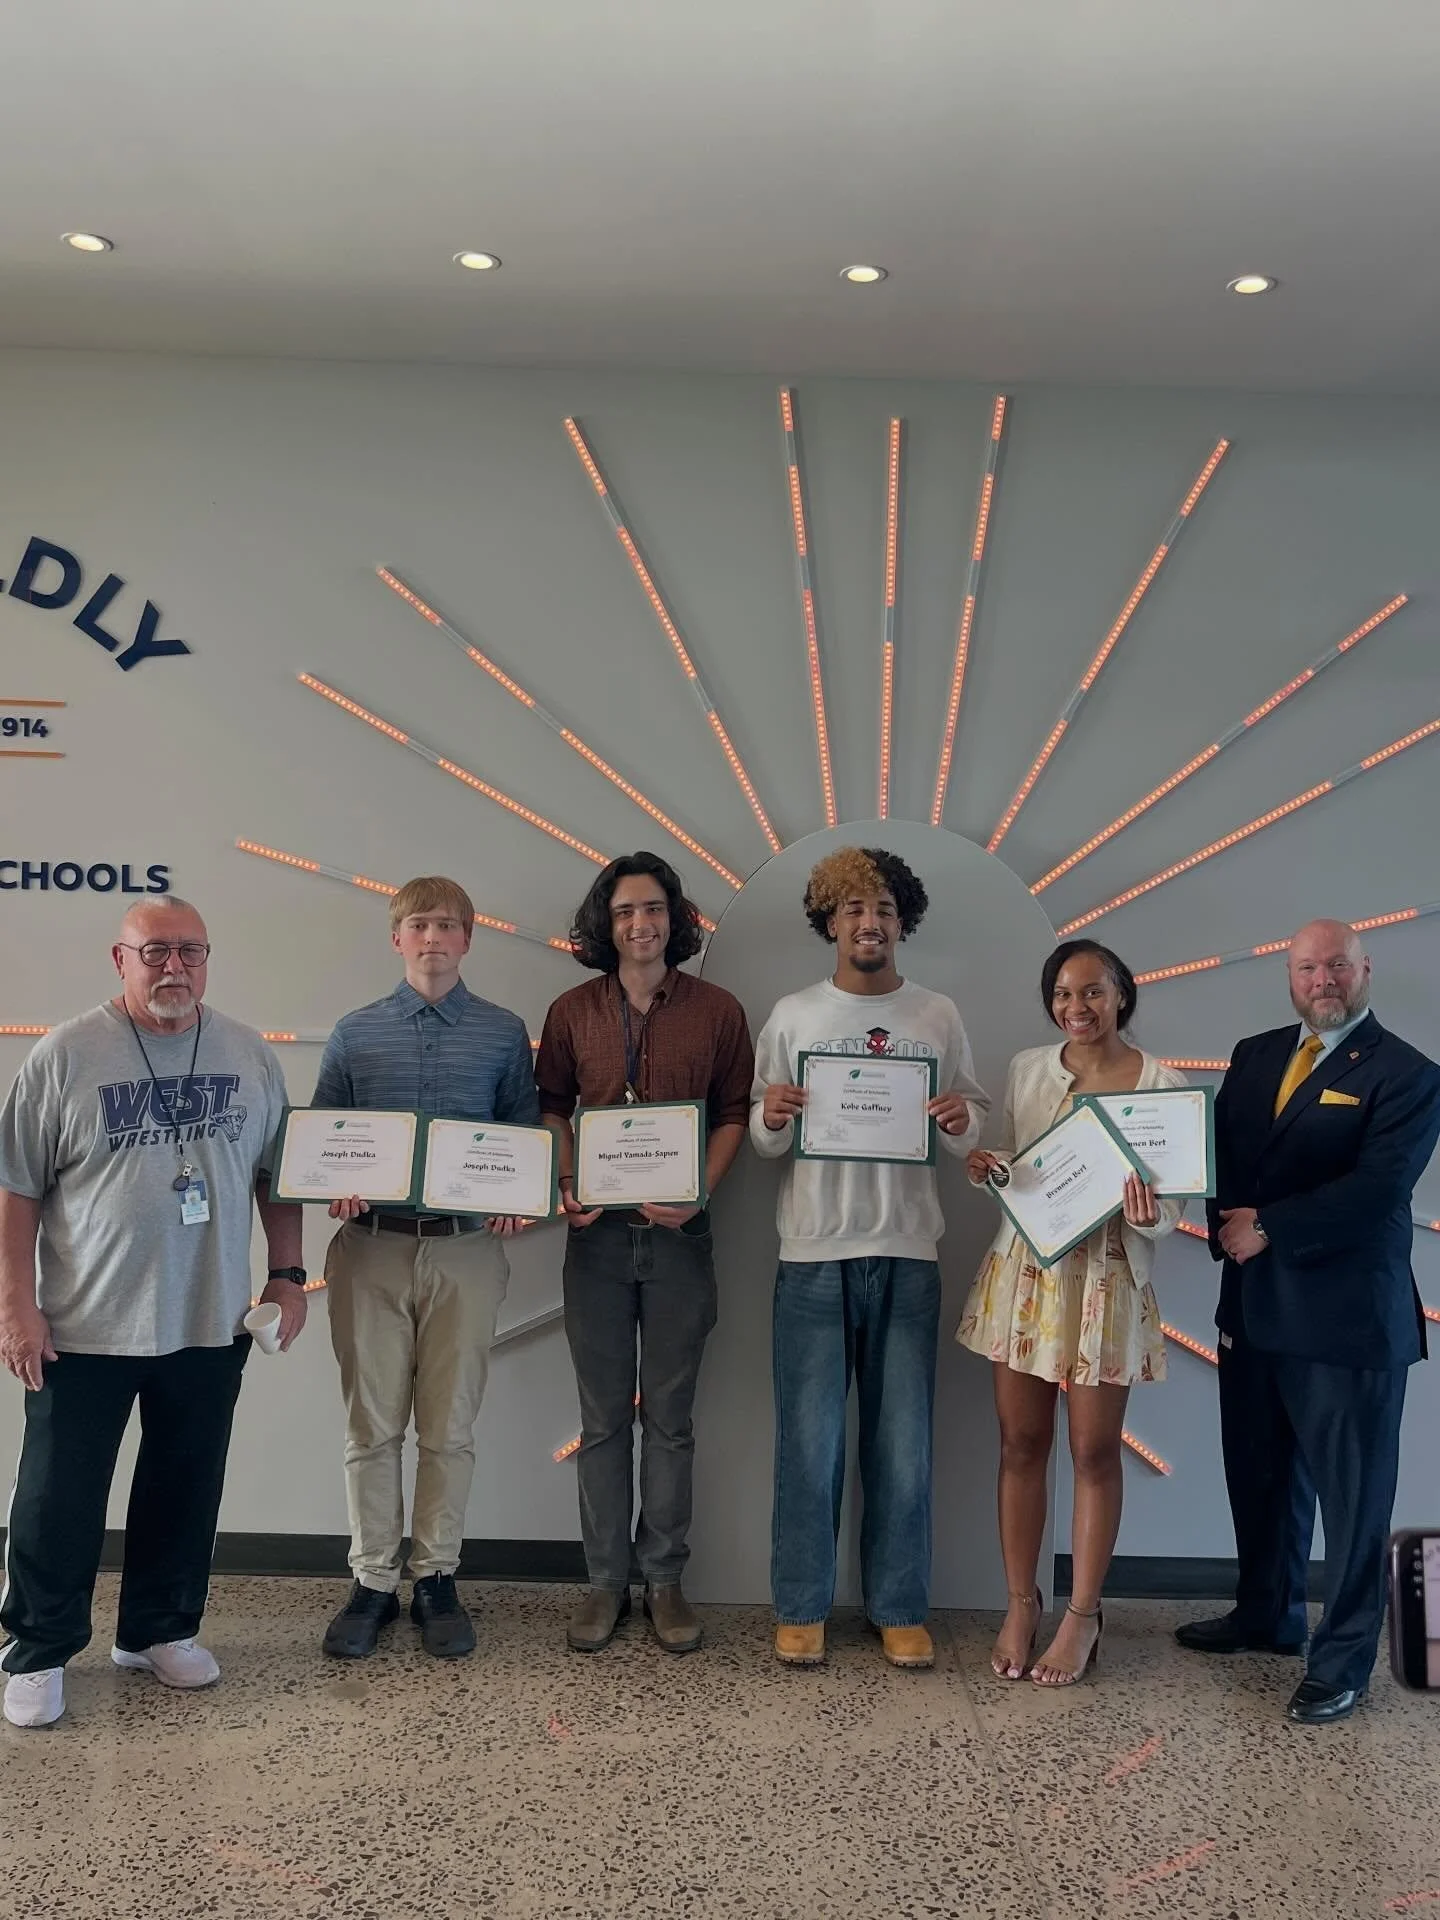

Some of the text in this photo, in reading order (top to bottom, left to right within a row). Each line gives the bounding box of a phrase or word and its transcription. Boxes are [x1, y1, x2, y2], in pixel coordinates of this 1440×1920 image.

[0, 536, 191, 671] DLY
[0, 860, 170, 893] CHOOLS
[99, 1074, 240, 1134] WEST
[861, 1103, 892, 1113] Gaffney
[321, 1150, 348, 1159] Joseph
[598, 1152, 622, 1161] Miguel
[463, 1162, 489, 1172] Joseph
